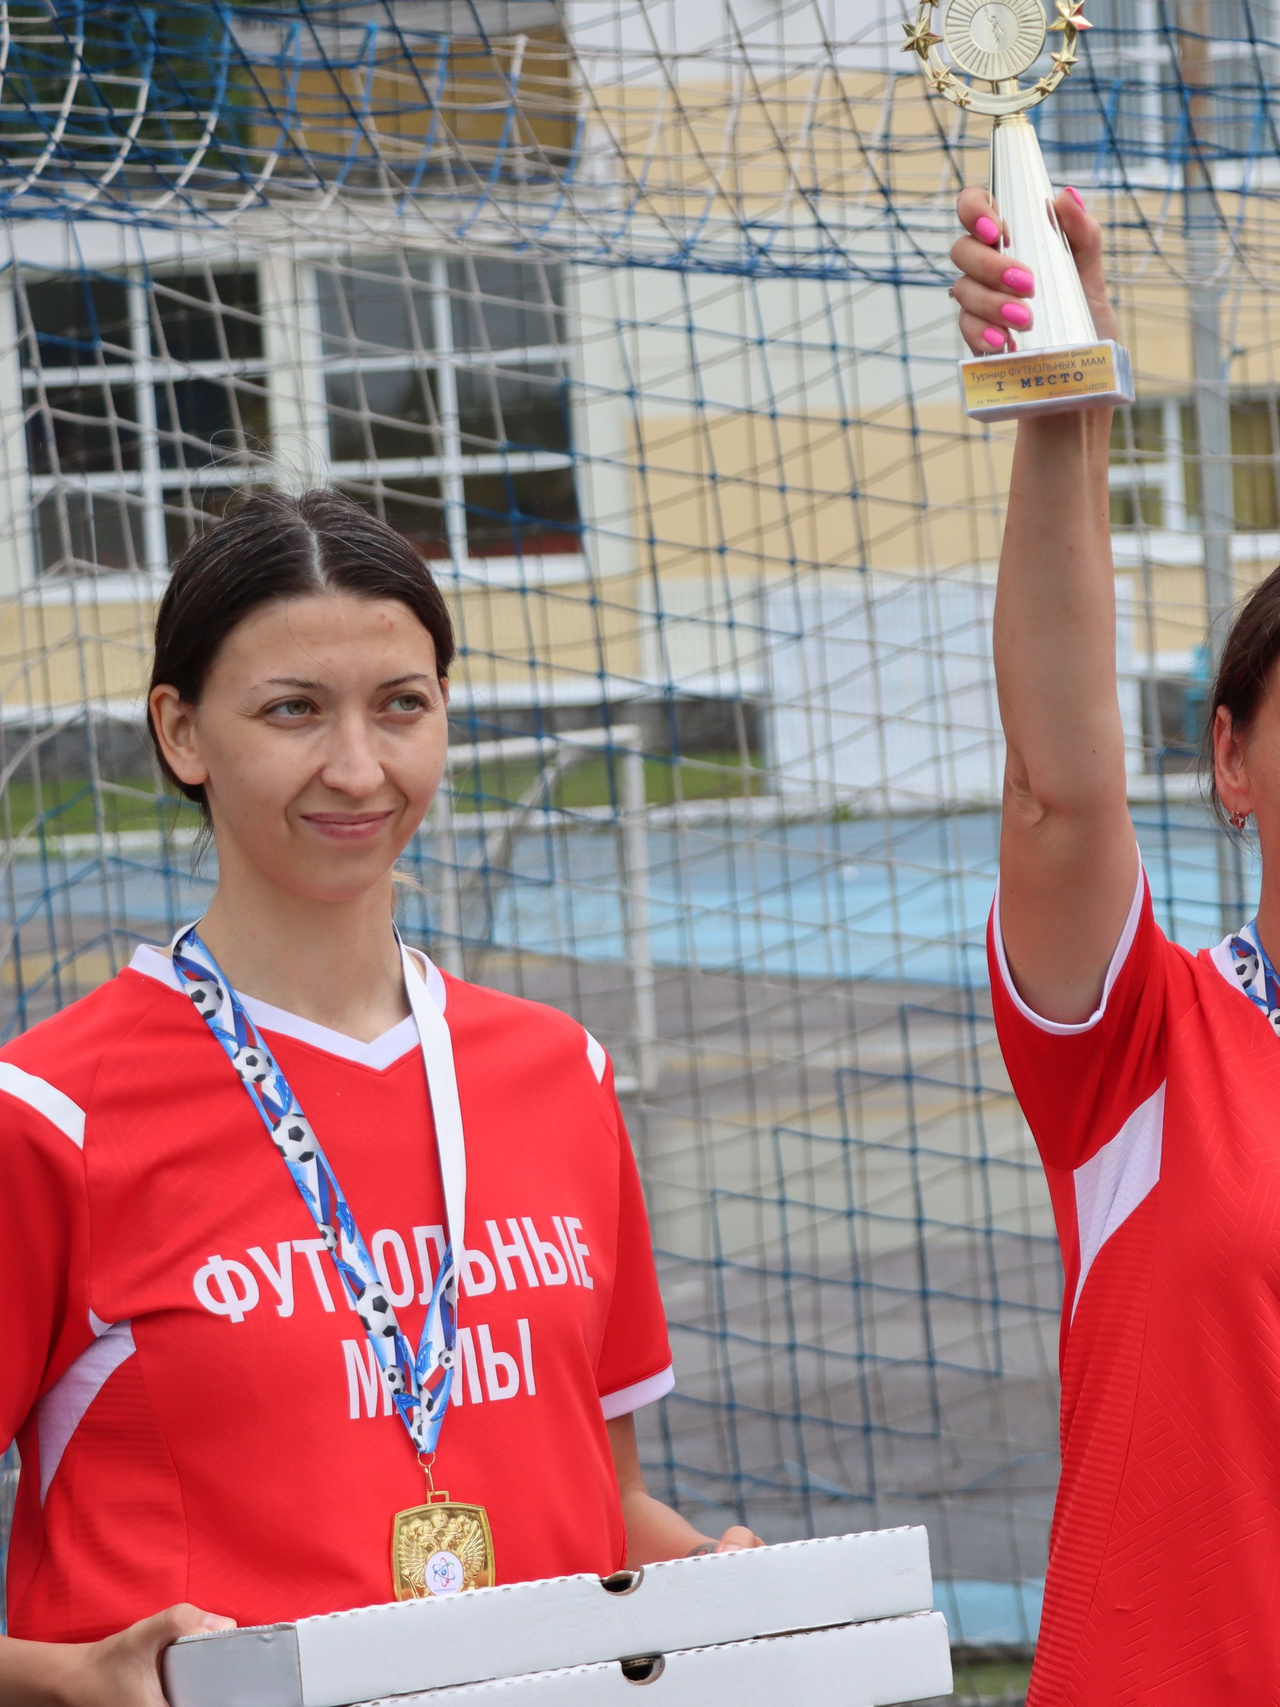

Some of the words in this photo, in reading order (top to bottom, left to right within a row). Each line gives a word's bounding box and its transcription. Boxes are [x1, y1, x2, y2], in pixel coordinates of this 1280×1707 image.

[971, 370, 1006, 382] Турнир
[1008, 359, 1077, 377] ФУТБОЛЬНЫХ
[1081, 356, 1107, 367] МАМ
[1021, 371, 1084, 388] МЕСТО
[193, 1215, 594, 1323] ФУТОЛЬНЫЕ
[341, 1318, 536, 1419] ММЫ
